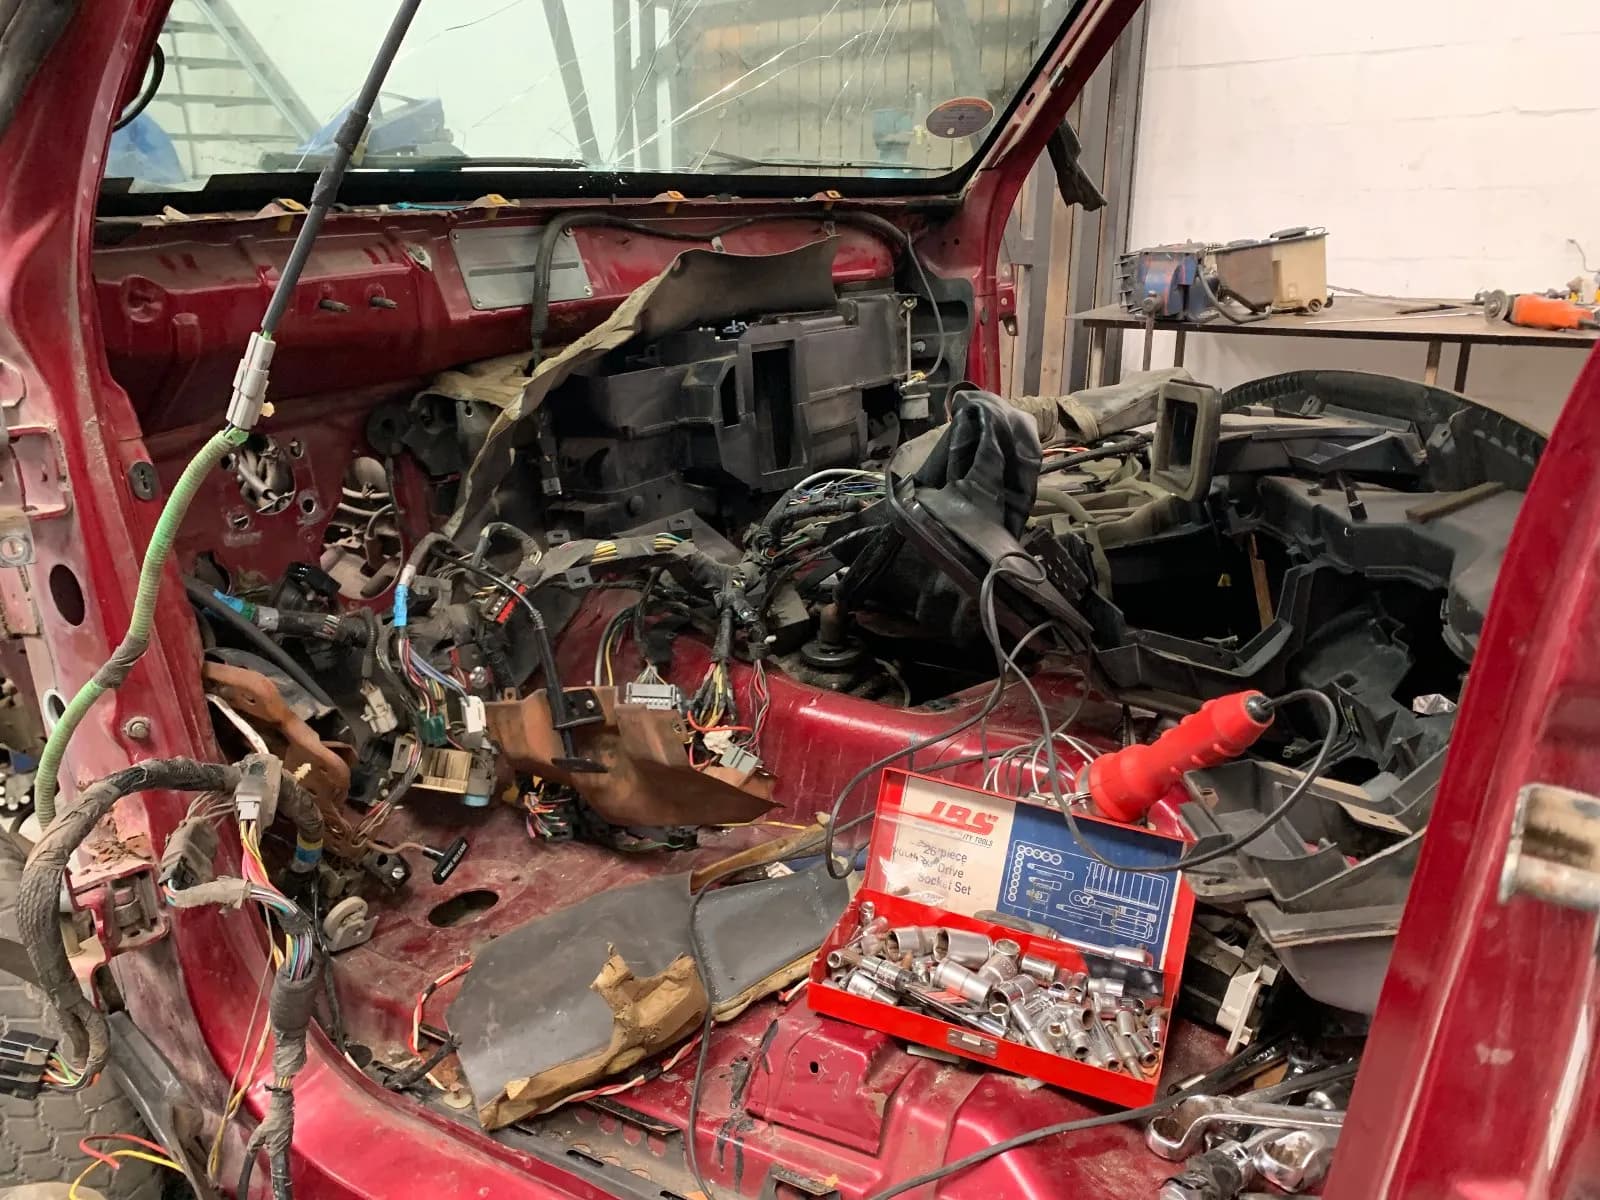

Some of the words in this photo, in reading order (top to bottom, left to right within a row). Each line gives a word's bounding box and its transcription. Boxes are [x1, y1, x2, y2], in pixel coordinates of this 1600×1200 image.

[939, 848, 968, 864] piece
[937, 862, 964, 879] Drive
[954, 881, 972, 896] Set
